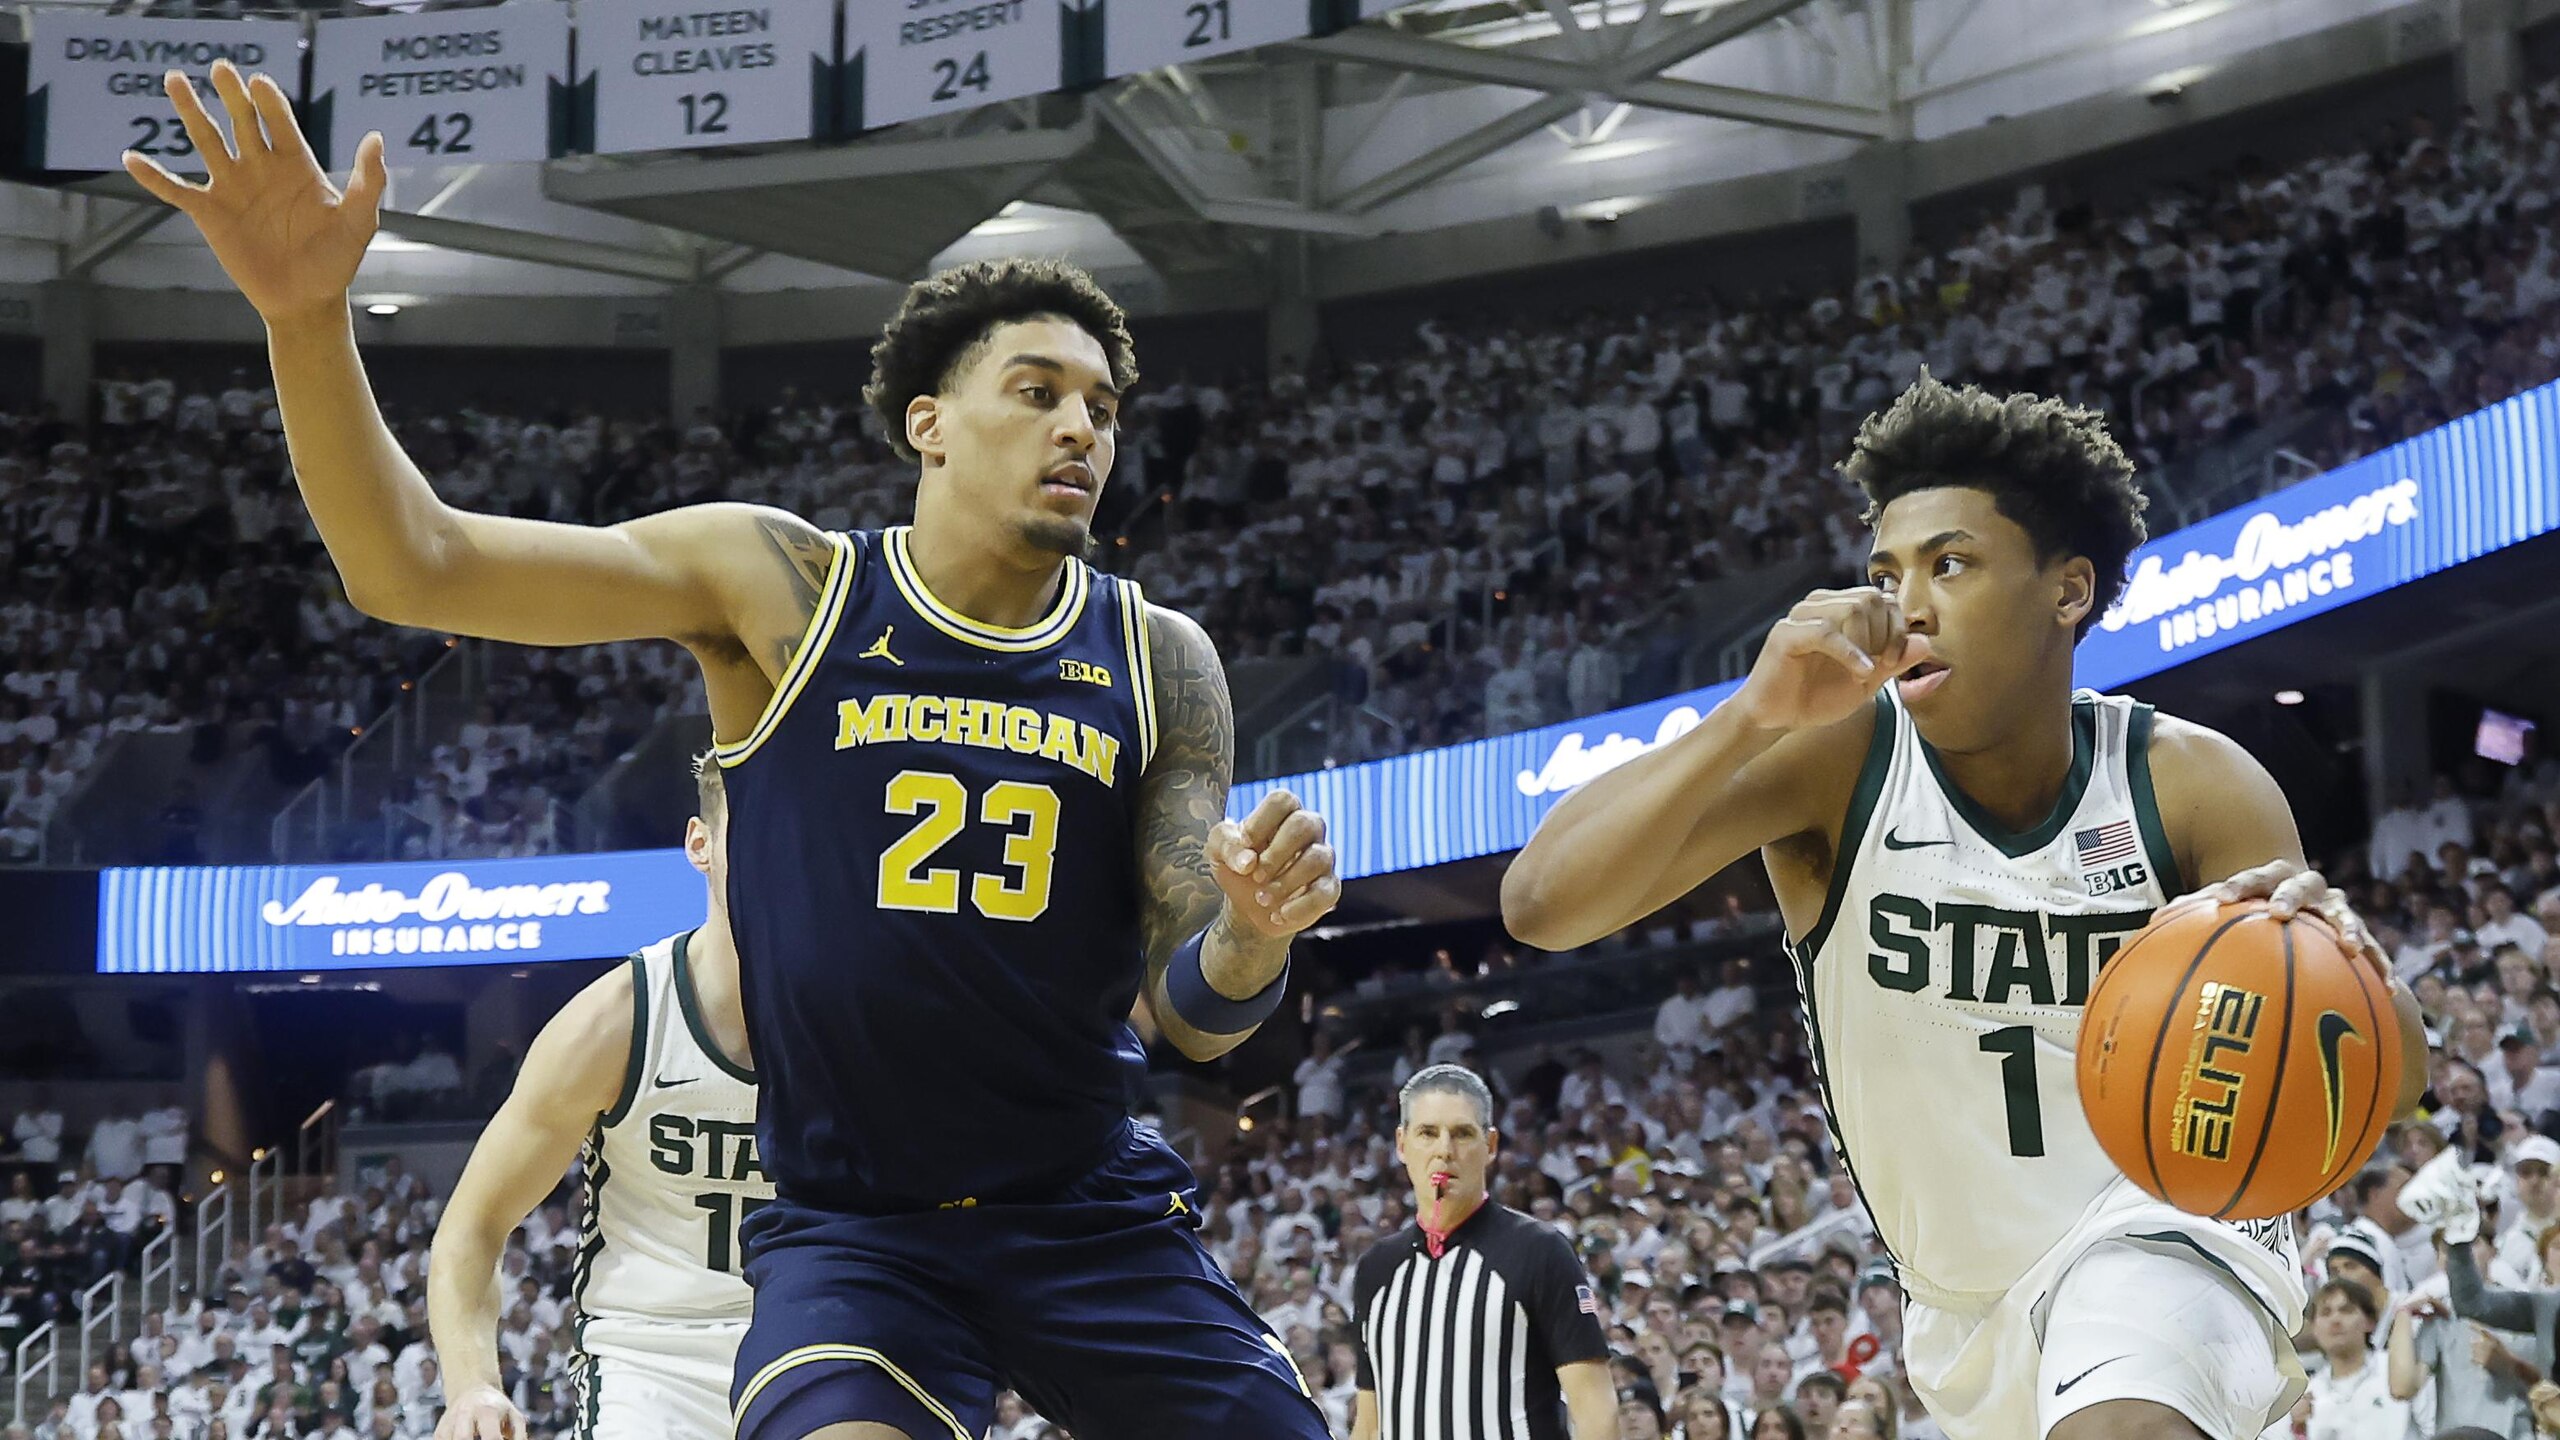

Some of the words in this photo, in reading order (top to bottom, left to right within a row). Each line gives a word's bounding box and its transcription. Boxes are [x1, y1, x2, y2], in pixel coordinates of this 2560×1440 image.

[382, 30, 500, 61] MORRIS
[639, 8, 770, 41] MATEEN
[900, 0, 1022, 45] RESPERT
[1184, 0, 1231, 47] 21
[65, 38, 265, 65] DRAYMOND
[633, 44, 775, 76] CLEAVES
[360, 64, 525, 97] PETERSON
[932, 50, 990, 102] 24
[130, 116, 196, 156] 23
[408, 112, 473, 154] 42
[678, 92, 728, 134] 12
[2100, 478, 2419, 632] Auto-Owners
[2159, 551, 2354, 652] INSURANCE
[835, 694, 1120, 788] MICHIGAN
[877, 770, 1061, 922] 23
[262, 872, 611, 926] Auto-Owners
[332, 921, 542, 956] INSURANCE
[1979, 1025, 2045, 1157] 1
[2183, 984, 2268, 1162] ELITE
[650, 1113, 778, 1182] STA
